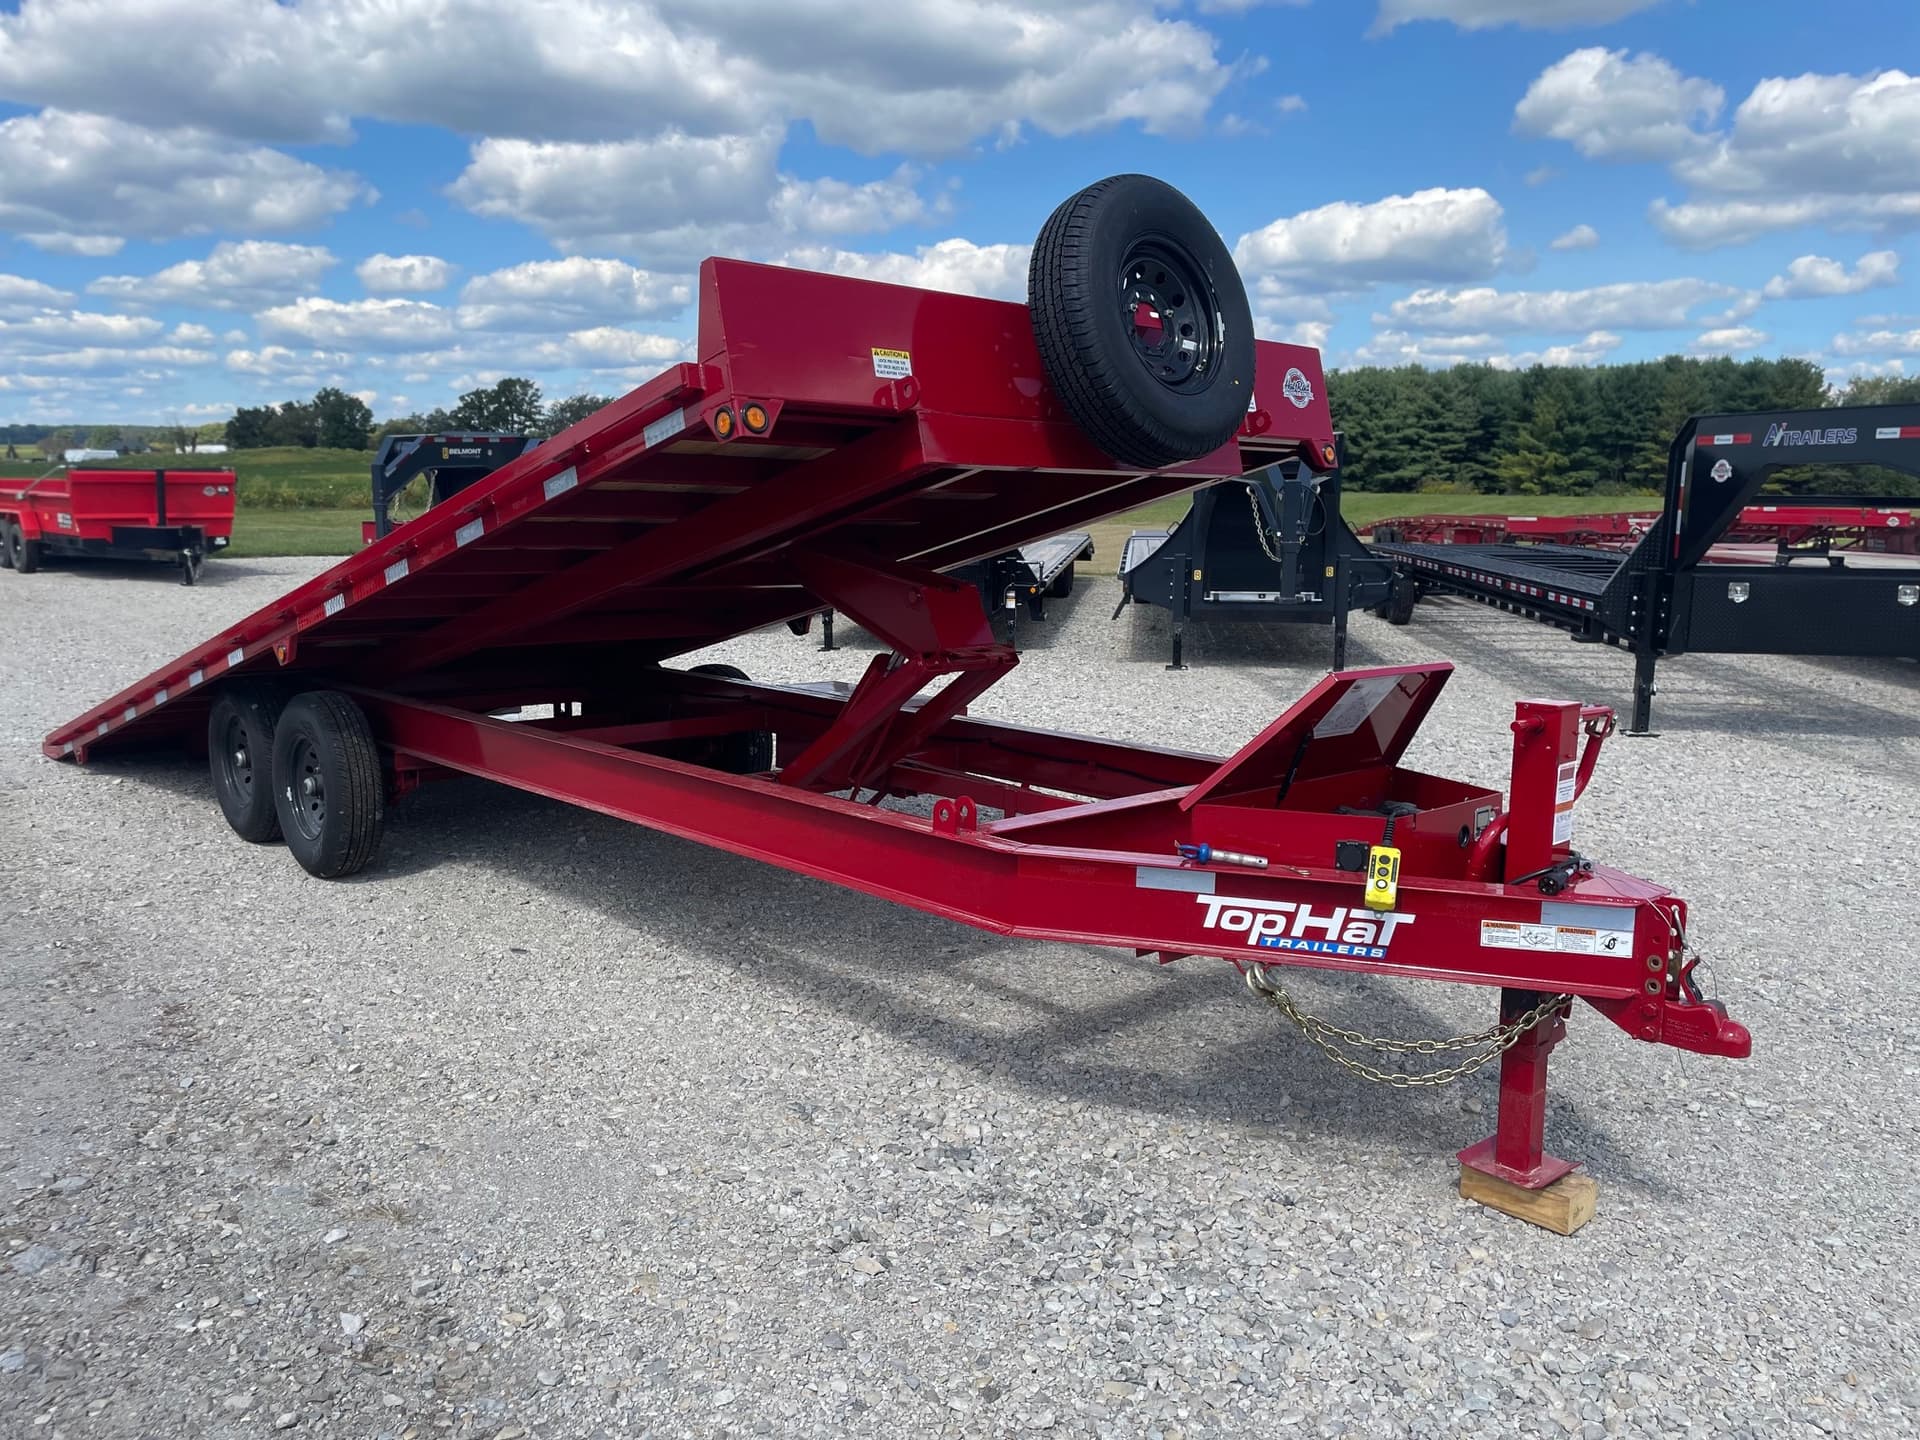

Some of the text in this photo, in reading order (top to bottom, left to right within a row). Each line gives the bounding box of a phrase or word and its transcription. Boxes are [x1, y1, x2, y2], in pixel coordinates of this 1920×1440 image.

[880, 350, 903, 358] CAUTION
[1783, 428, 1858, 446] TRAILERS
[448, 447, 482, 455] BELMONT
[1262, 936, 1385, 959] TRAILERS
